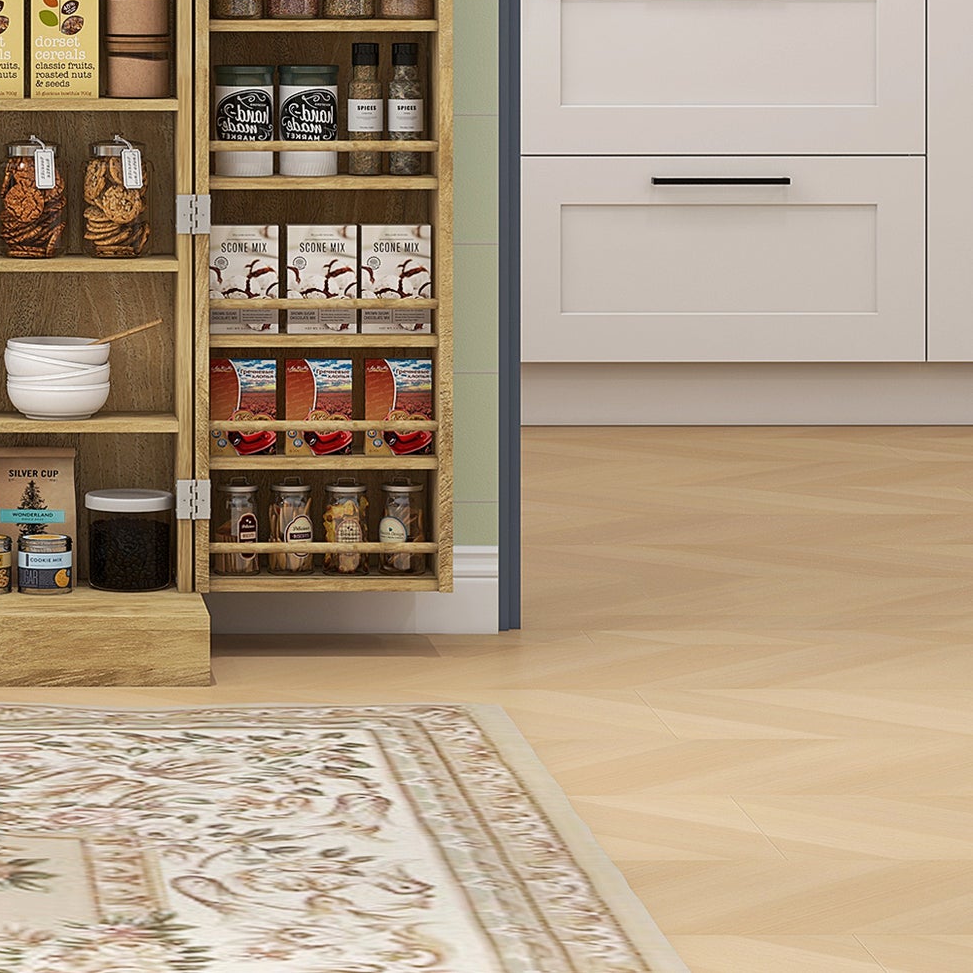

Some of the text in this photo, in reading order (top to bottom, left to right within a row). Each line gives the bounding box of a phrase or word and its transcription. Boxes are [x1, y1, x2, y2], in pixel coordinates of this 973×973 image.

[35, 35, 81, 47] dorset
[35, 49, 86, 60] cereals
[68, 62, 95, 70] fruits,
[221, 242, 267, 253] SCONE MIX
[299, 242, 345, 253] SCONE MIX
[373, 242, 419, 253] SCONE MIX
